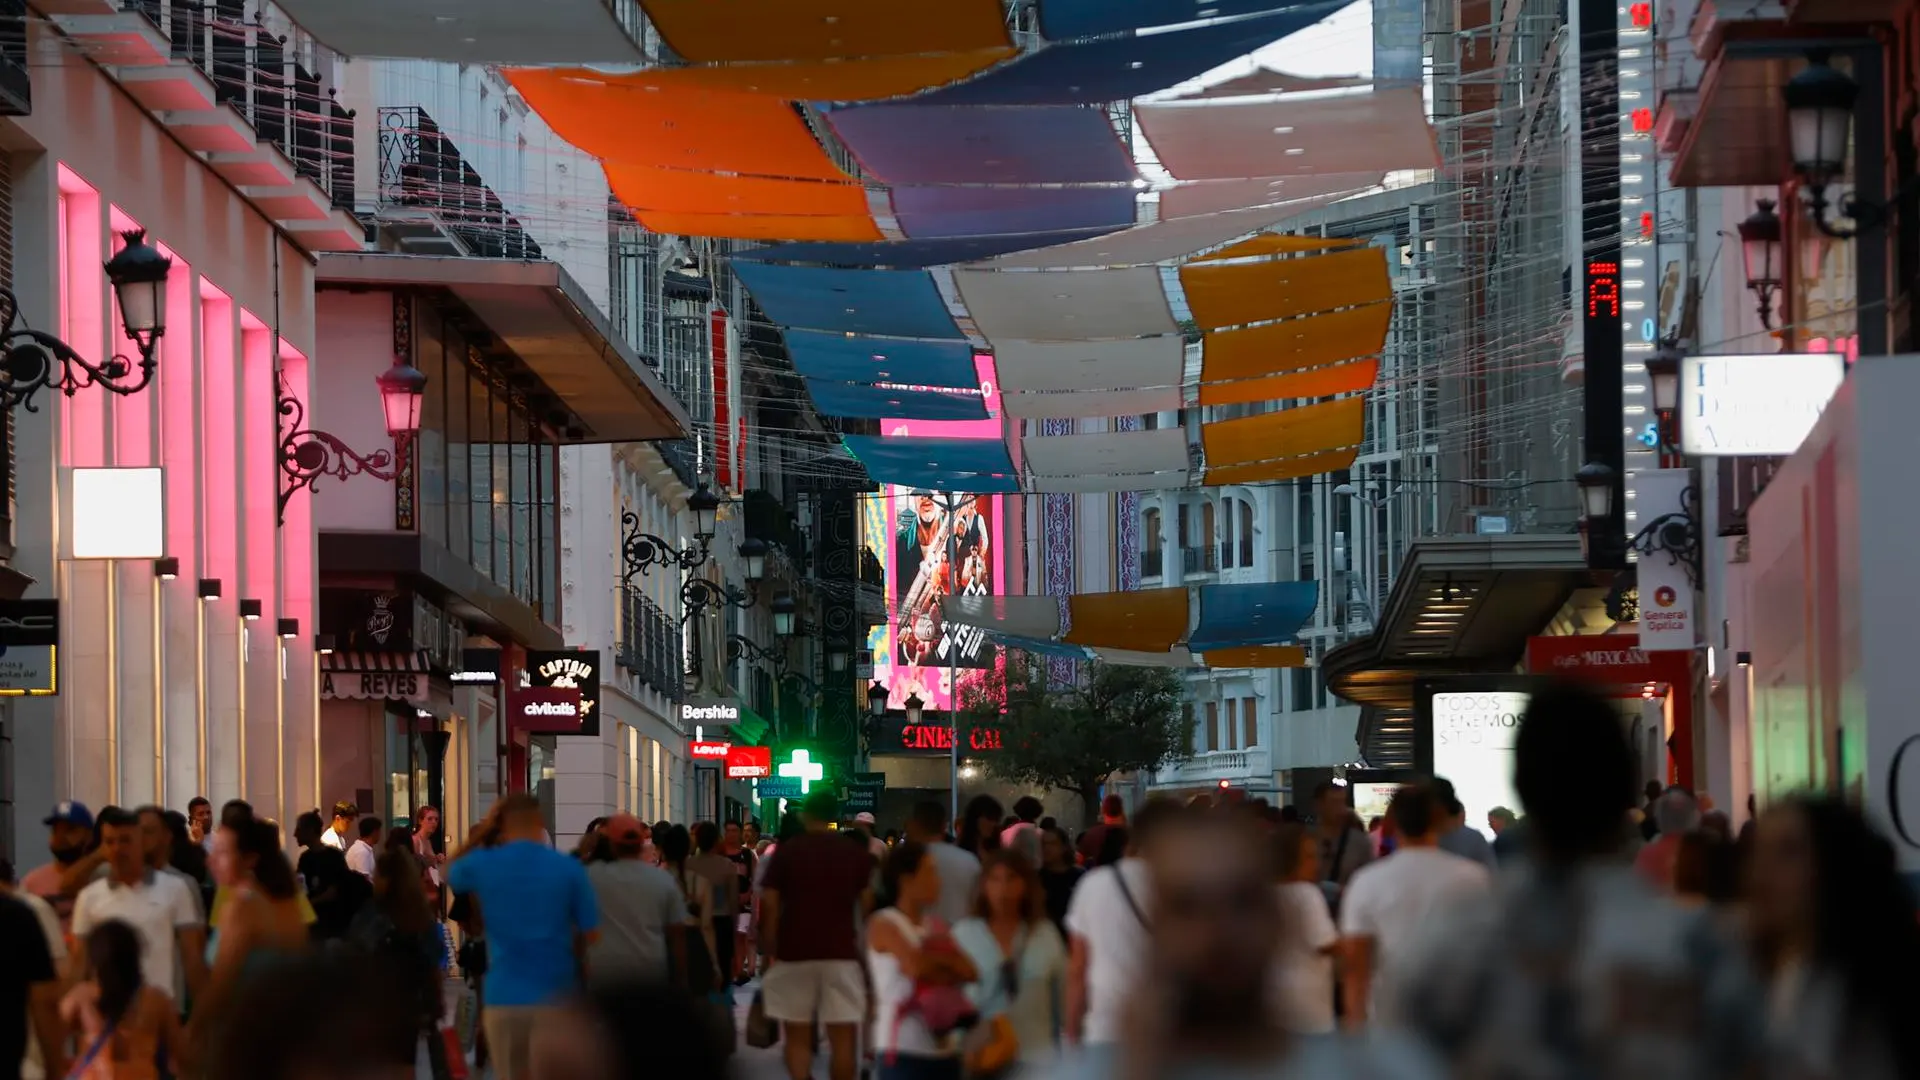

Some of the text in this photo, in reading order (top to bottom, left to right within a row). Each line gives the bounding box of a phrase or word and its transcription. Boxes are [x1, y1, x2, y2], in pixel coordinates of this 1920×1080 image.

[1630, 3, 1652, 27] 15
[1641, 212, 1653, 236] 5
[1642, 318, 1655, 341] 0
[1644, 610, 1687, 620] General
[1649, 622, 1684, 632] Optica
[539, 659, 592, 679] CAPTAIN
[361, 673, 418, 695] REYES
[524, 702, 576, 716] civitatis
[1439, 696, 1500, 711] TODOS
[682, 704, 737, 720] Bershka
[1440, 730, 1482, 745] STO
[758, 777, 796, 786] CHANG
[762, 787, 798, 796] MONEY
